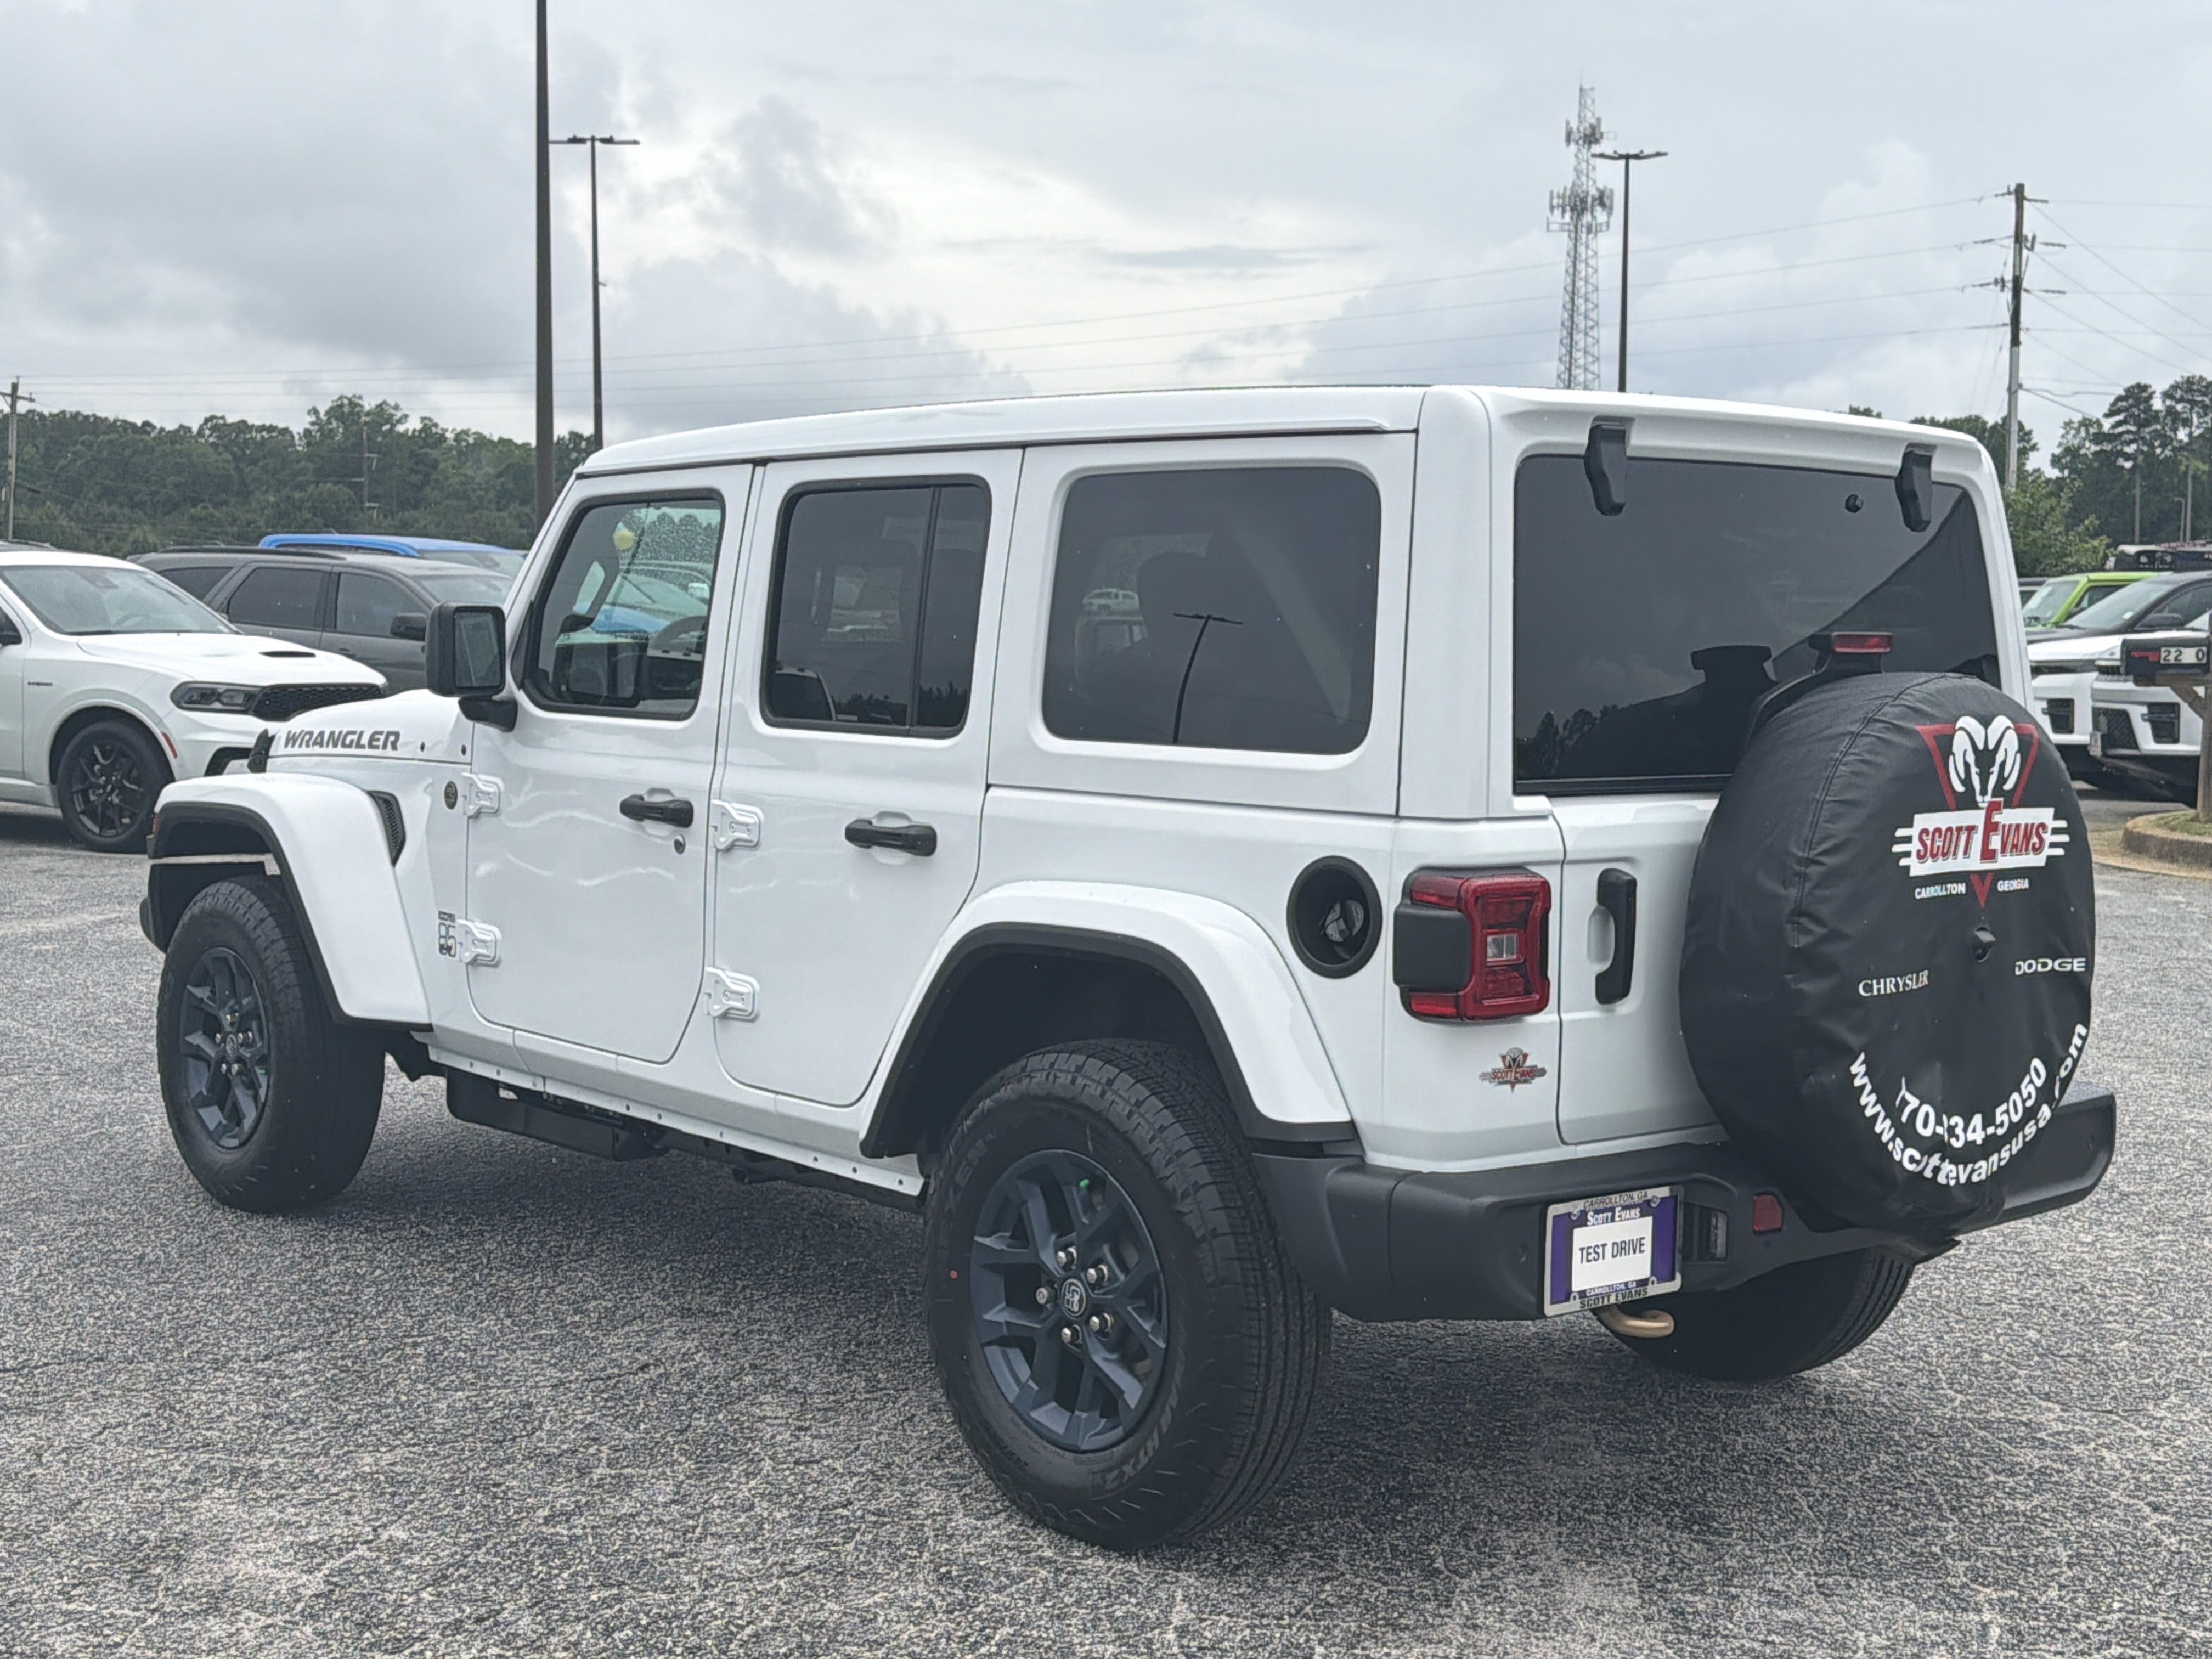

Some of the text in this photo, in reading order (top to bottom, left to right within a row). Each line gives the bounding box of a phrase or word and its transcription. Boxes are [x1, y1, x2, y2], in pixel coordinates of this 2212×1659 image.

[284, 729, 400, 751] WRANGLER
[1916, 798, 2048, 864] SCOTT EVANS
[1914, 878, 2029, 900] CARROLLTON GEORGIA
[2015, 958, 2086, 976] DODGE
[1858, 970, 1929, 997] CHRYSLER
[1895, 1057, 2047, 1149] 70-34-5050
[1587, 1206, 1640, 1226] SCOTT EVANS
[1579, 1237, 1646, 1263] TEST DRIVE
[1580, 1288, 1648, 1309] SCOTT EVANS
